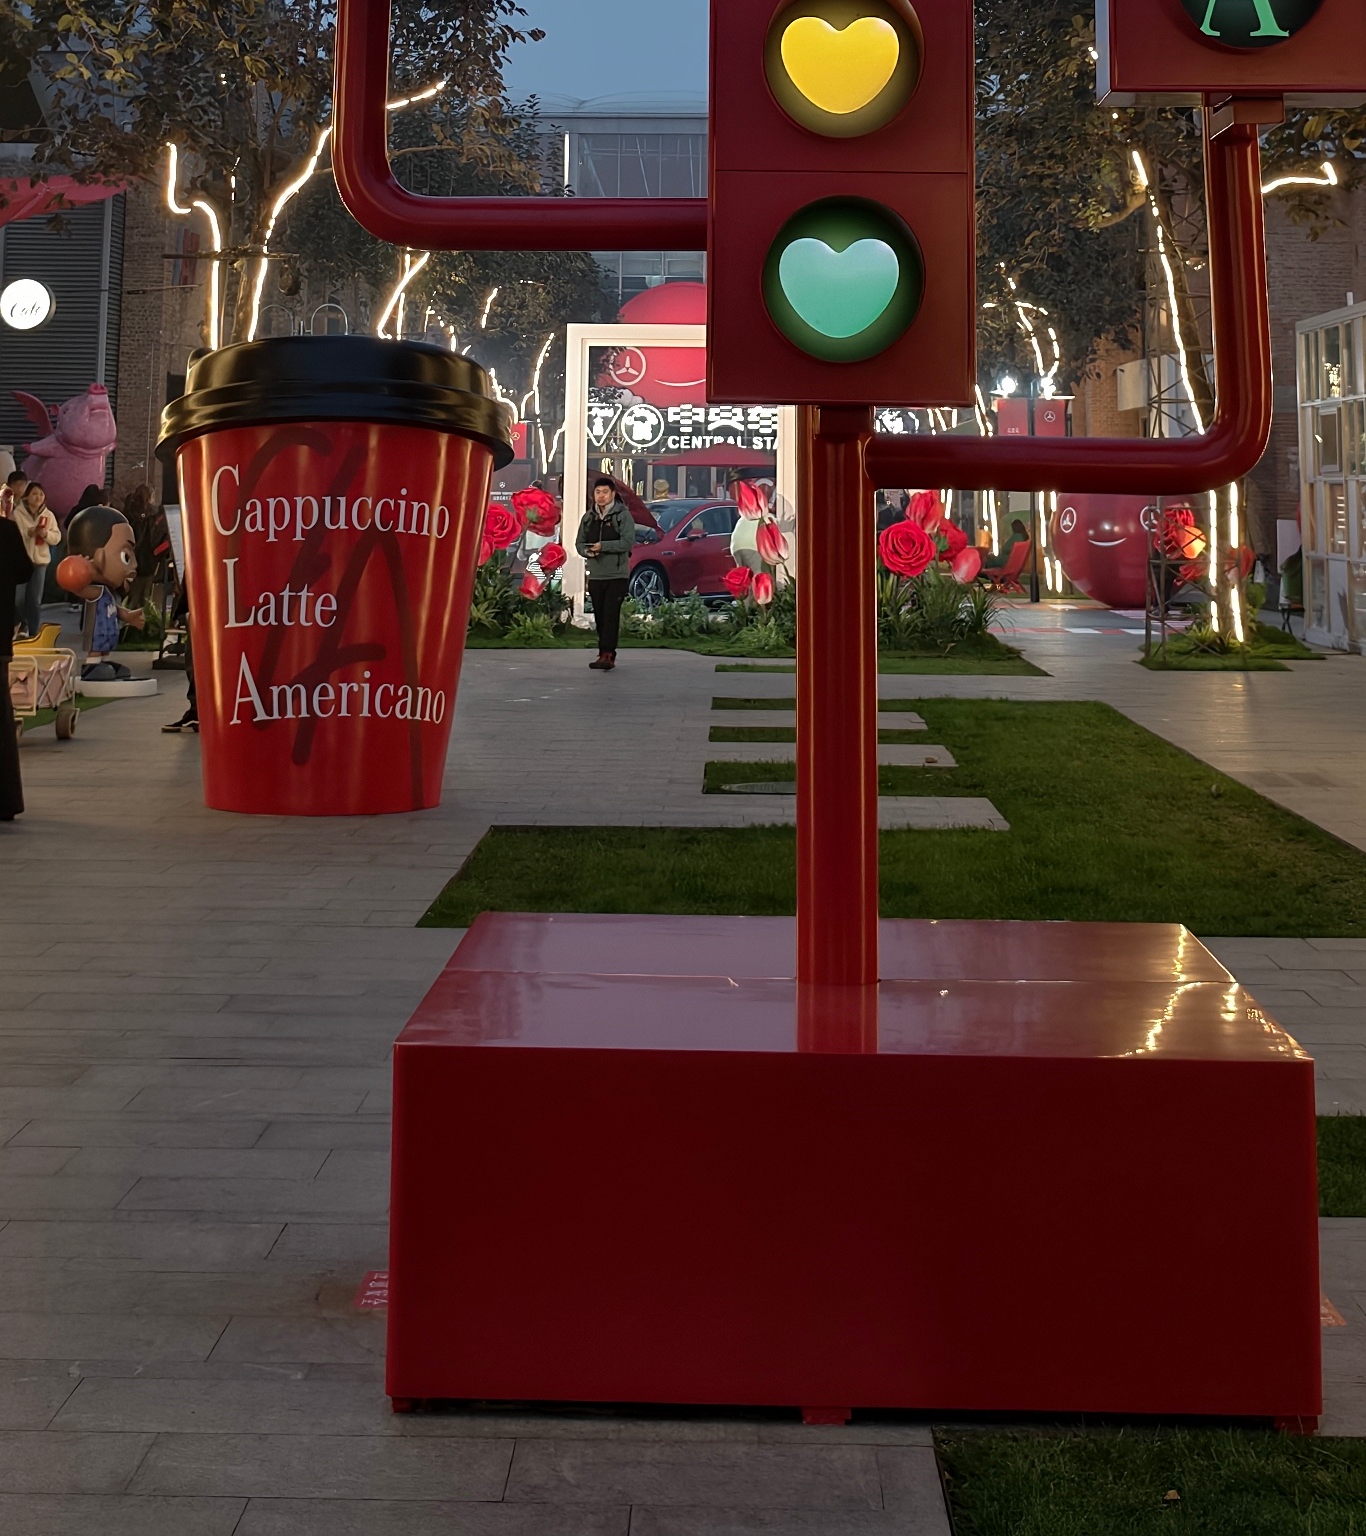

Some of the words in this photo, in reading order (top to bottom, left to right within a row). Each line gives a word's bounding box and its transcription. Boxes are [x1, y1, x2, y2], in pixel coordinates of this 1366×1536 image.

[211, 464, 451, 544] Cappuccino
[221, 557, 338, 629] Latte
[230, 651, 446, 725] Americano
